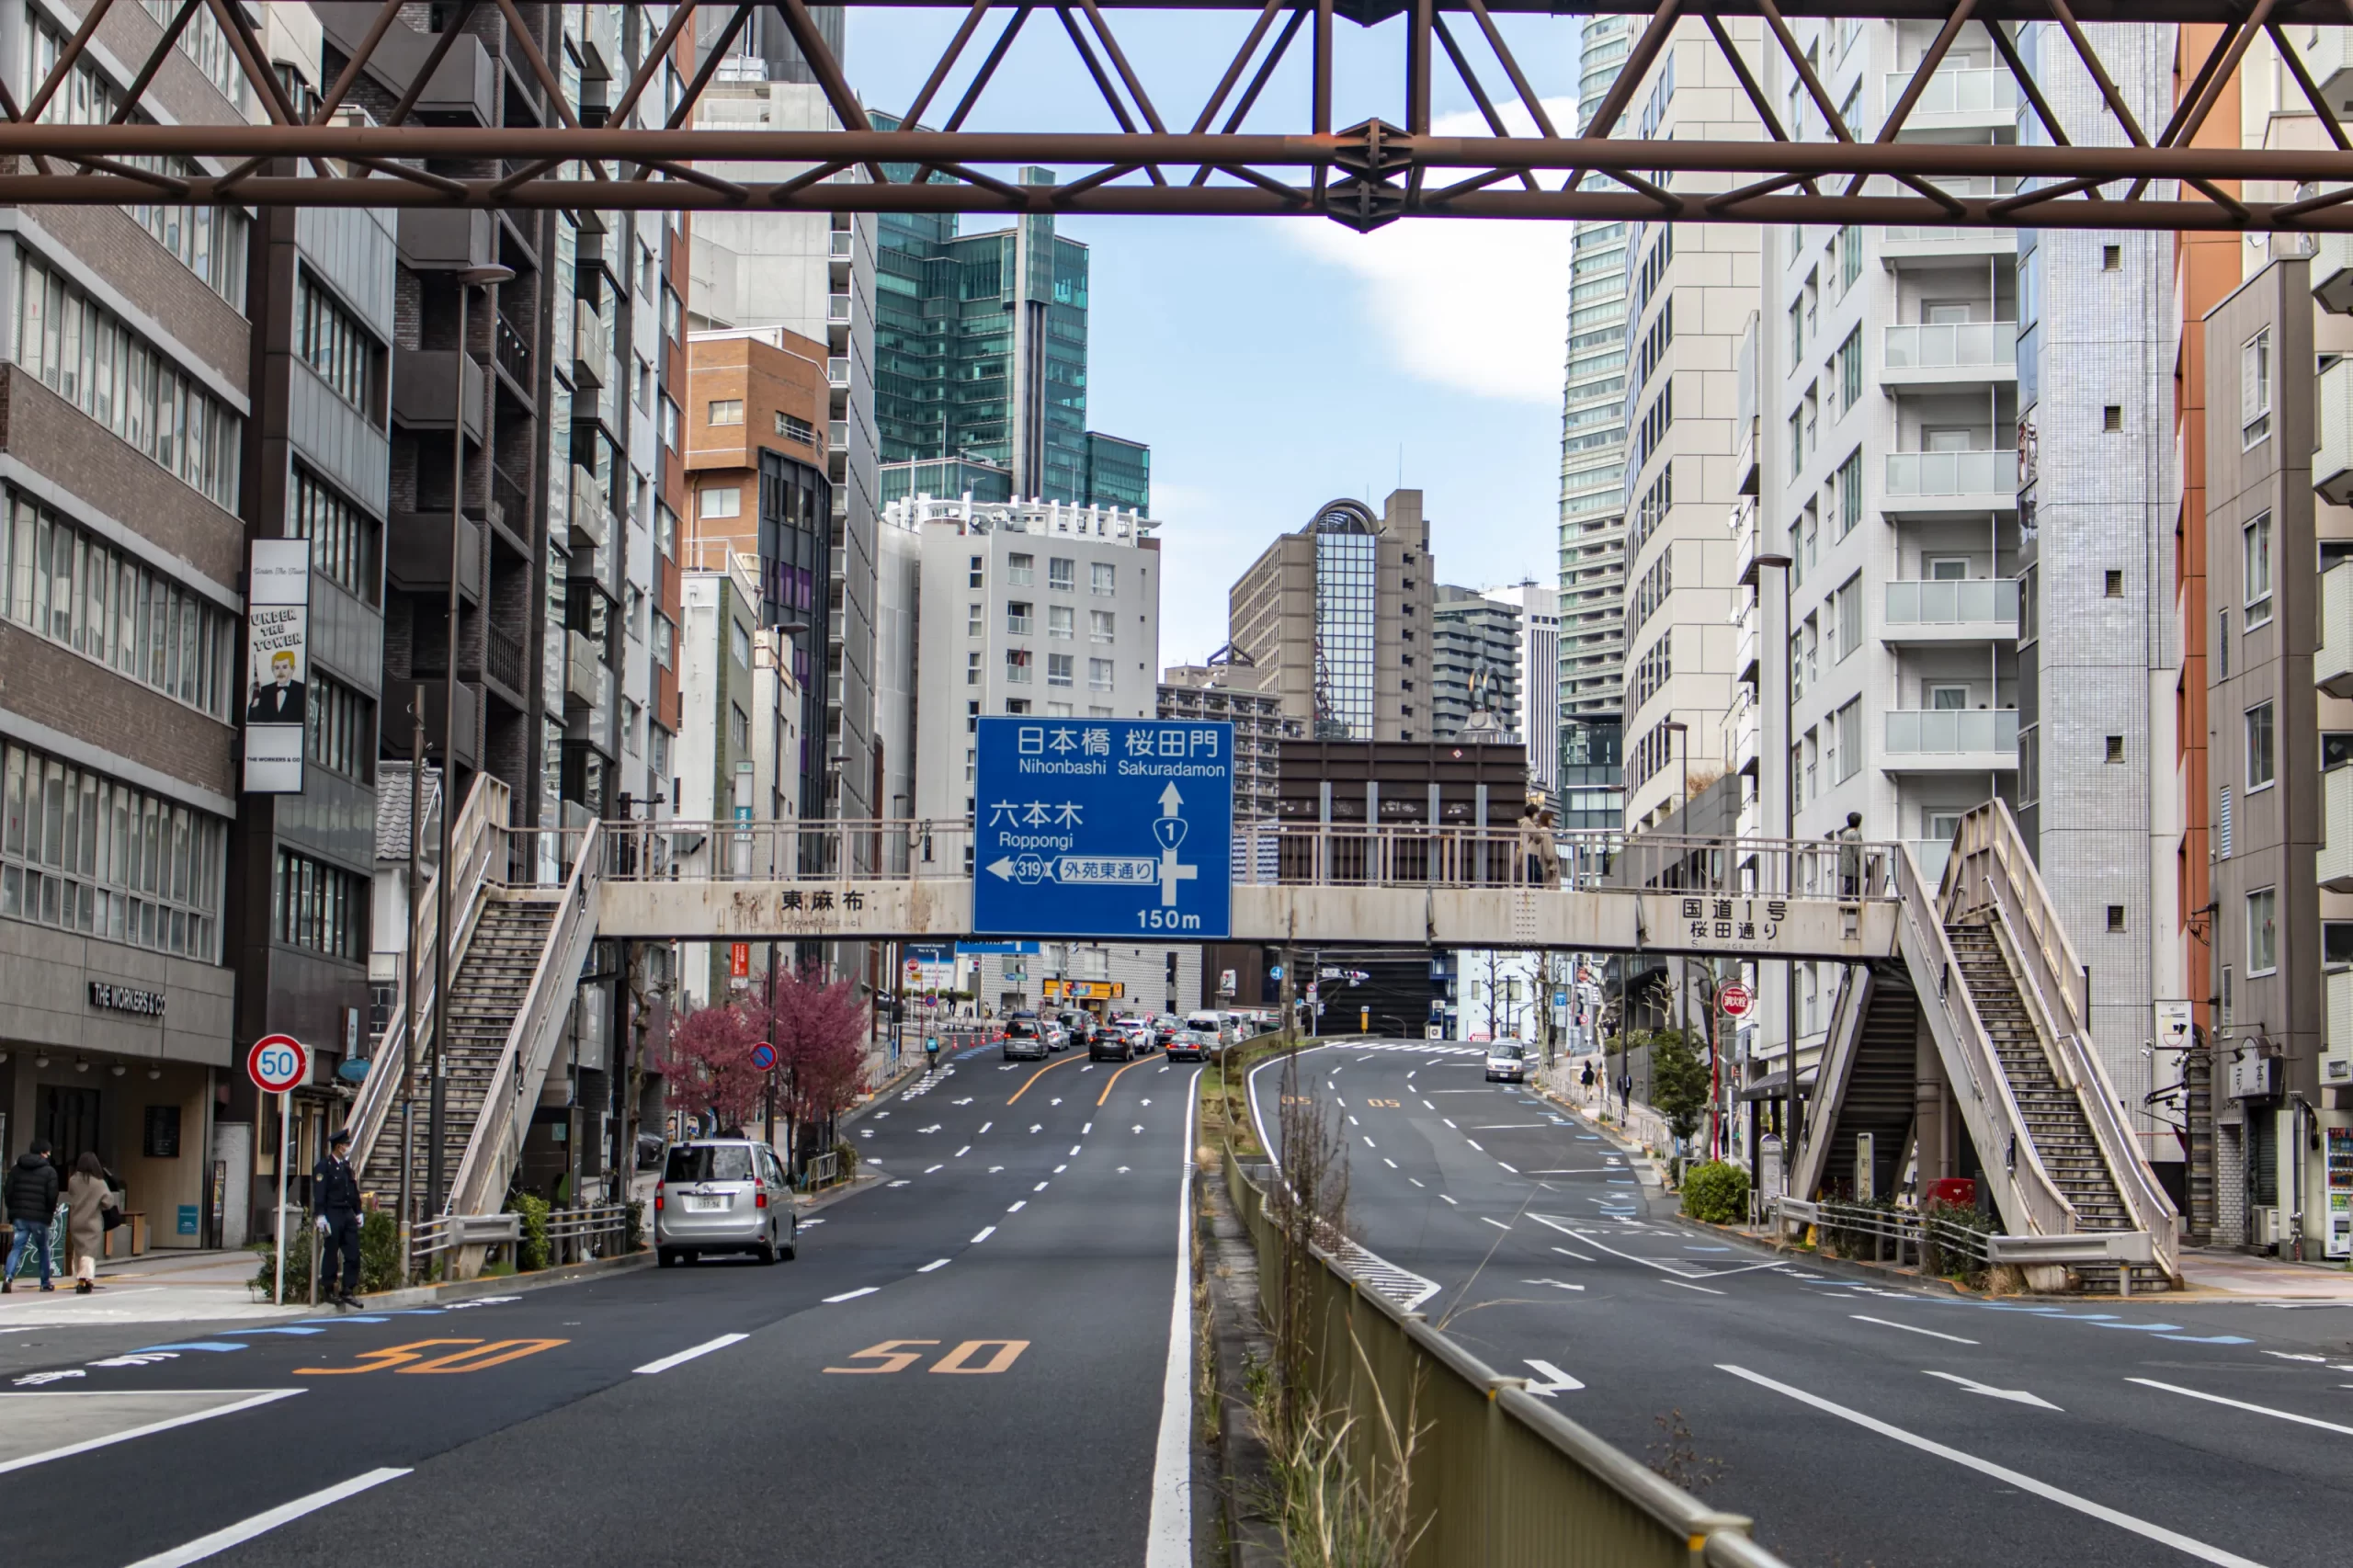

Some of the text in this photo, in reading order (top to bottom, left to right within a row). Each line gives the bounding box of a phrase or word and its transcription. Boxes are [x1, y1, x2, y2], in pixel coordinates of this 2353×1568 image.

[251, 608, 297, 627] UNDER
[260, 623, 285, 637] THE
[254, 632, 302, 652] TOWER
[1018, 726, 1218, 758] 日本橋 桜田門
[1019, 758, 1225, 778] Nihonbashi Sakuradamon
[989, 800, 1084, 830] 六本木
[999, 832, 1074, 851] Roppongi
[1165, 823, 1174, 841] 1
[1017, 860, 1040, 877] 319
[1063, 861, 1152, 880] 外苑東通り
[781, 890, 865, 912] 東麻布
[1683, 898, 1788, 922] 国道1号
[1137, 910, 1200, 929] 150m
[1690, 920, 1779, 940] 桜田通り
[95, 983, 166, 1017] THE WORKERS & CO
[1723, 994, 1747, 1007] 消火栓
[261, 1051, 294, 1076] 50
[291, 1338, 572, 1375] 50
[822, 1338, 1031, 1375] 50
